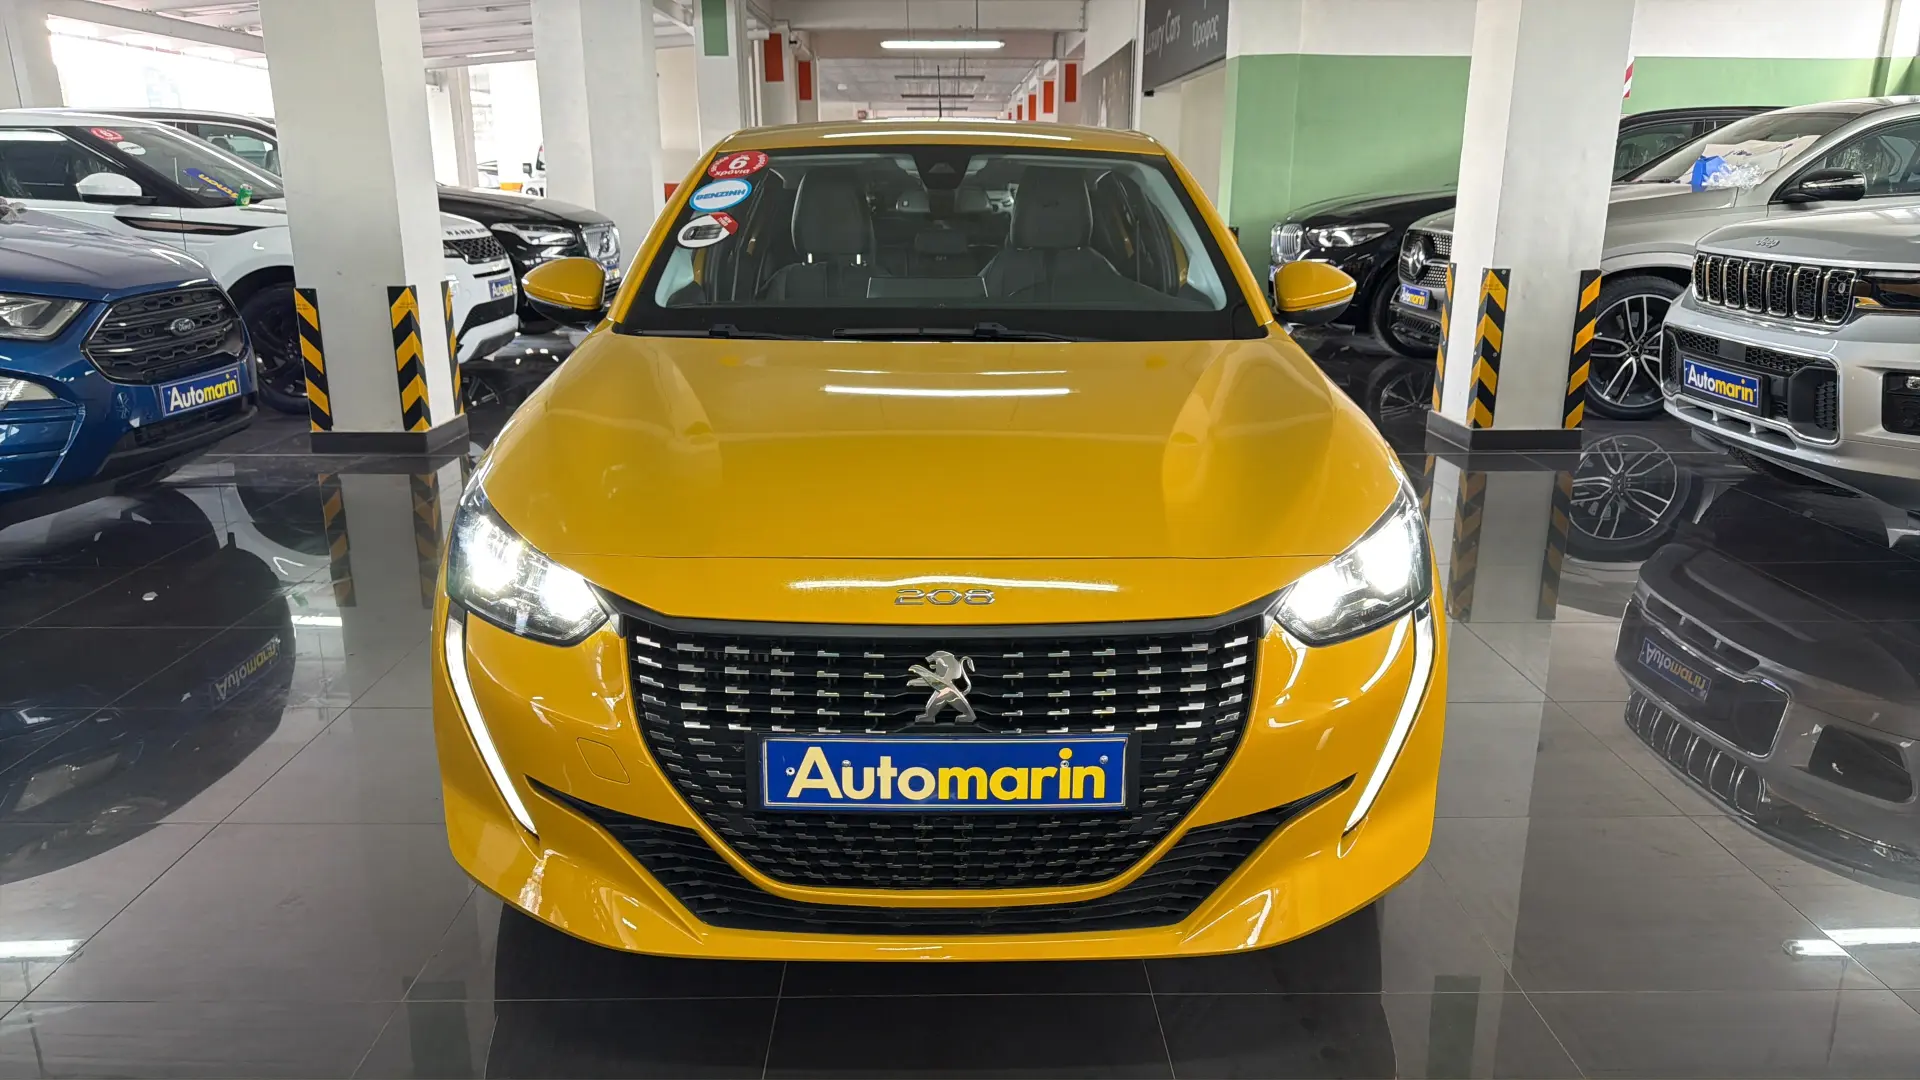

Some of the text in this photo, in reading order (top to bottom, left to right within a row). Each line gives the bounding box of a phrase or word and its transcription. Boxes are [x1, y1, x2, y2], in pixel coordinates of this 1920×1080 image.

[1165, 9, 1181, 45] Cars
[728, 156, 750, 170] 6
[170, 373, 238, 411] Automarin
[1687, 364, 1754, 403] Automarin
[894, 588, 996, 605] 208
[787, 746, 1106, 800] Automarin
